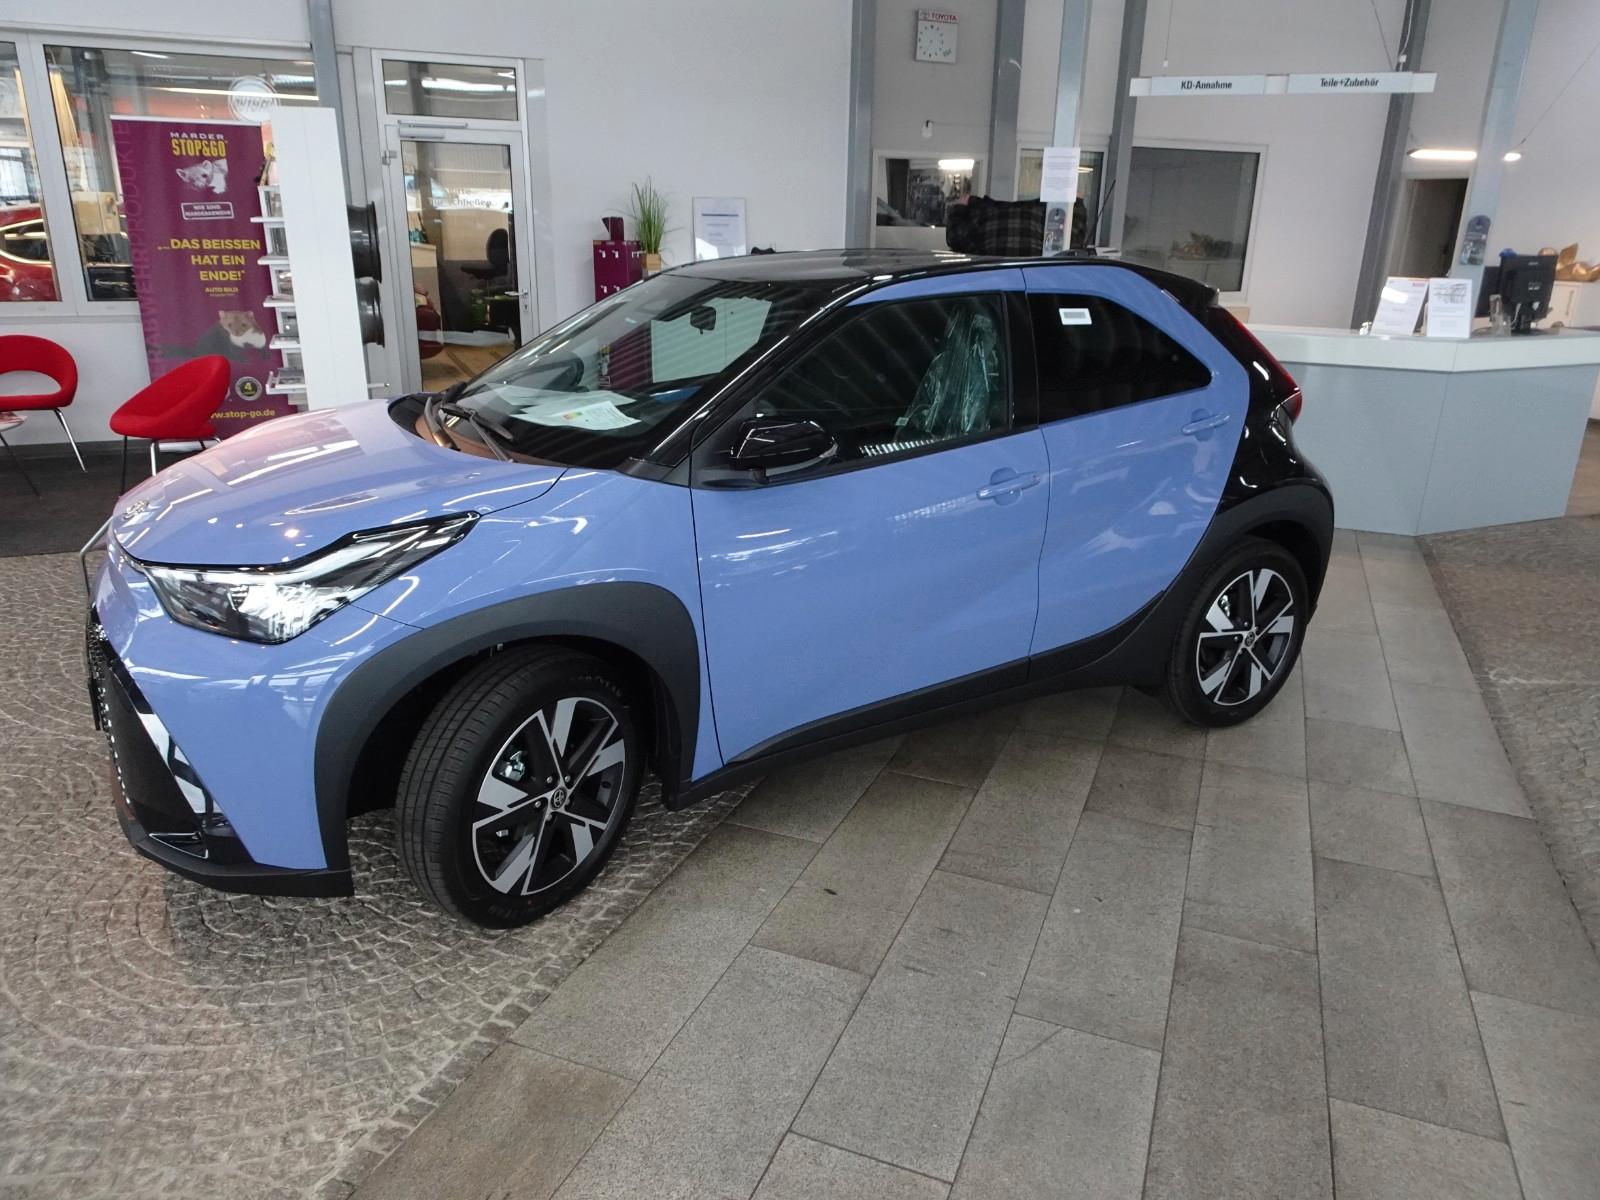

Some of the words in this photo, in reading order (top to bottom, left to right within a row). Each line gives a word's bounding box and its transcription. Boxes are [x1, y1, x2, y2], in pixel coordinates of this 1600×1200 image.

[931, 12, 958, 22] TOYOTA
[1181, 80, 1233, 90] KD-Annahme
[1320, 77, 1379, 88] Teile+Zubehör
[170, 132, 225, 140] MARDER
[171, 138, 226, 157] STOP&GO
[202, 239, 261, 250] BEISSEN
[191, 255, 219, 266] HAT
[221, 255, 246, 266] EIN
[211, 409, 276, 419] w.stop-go.de
